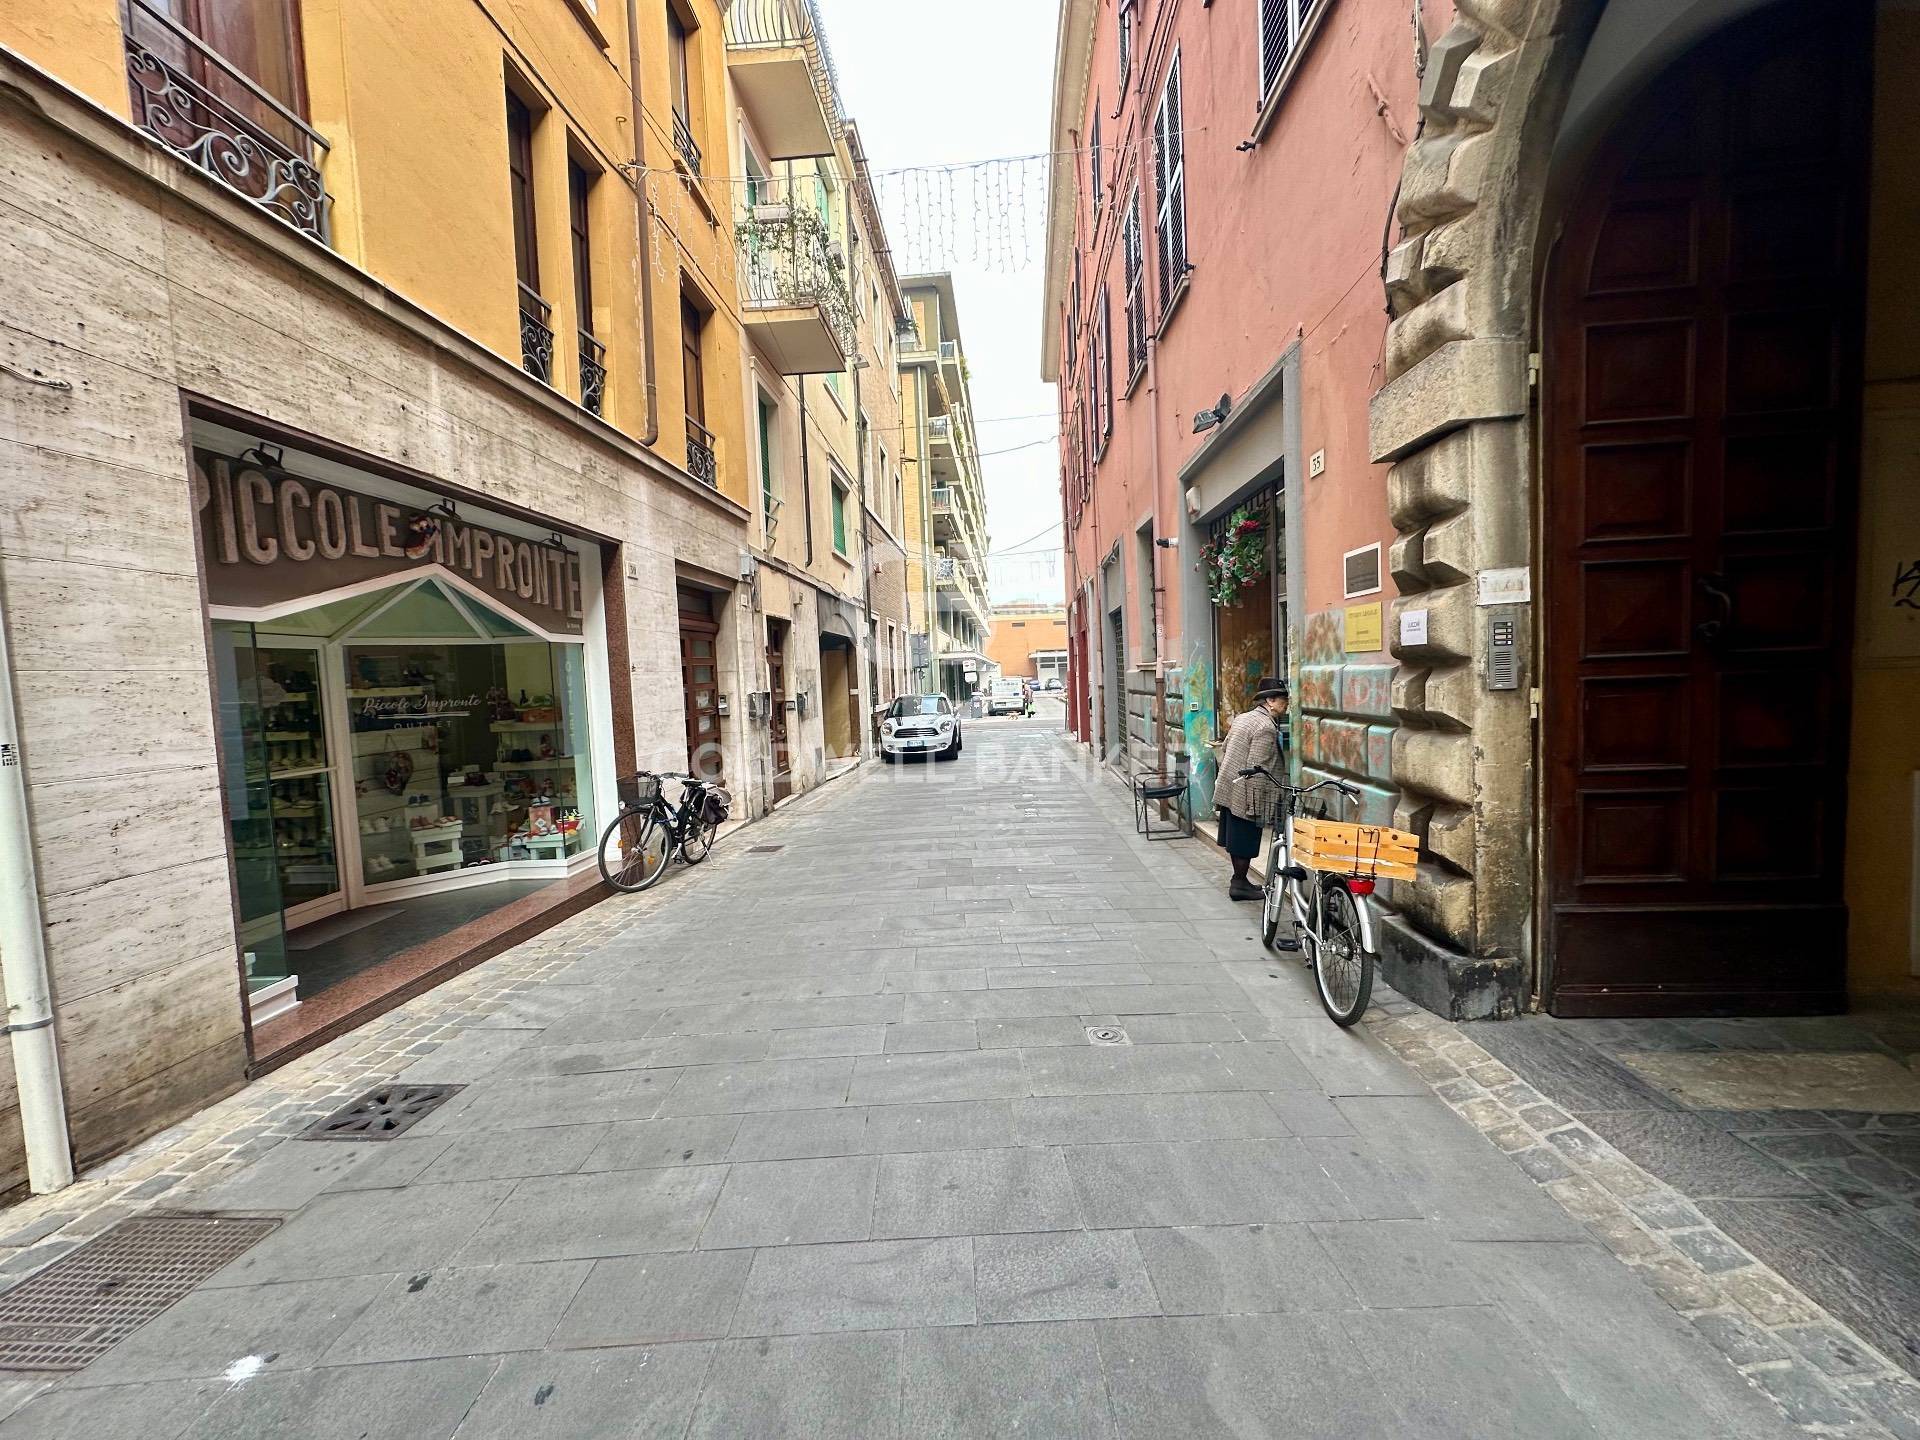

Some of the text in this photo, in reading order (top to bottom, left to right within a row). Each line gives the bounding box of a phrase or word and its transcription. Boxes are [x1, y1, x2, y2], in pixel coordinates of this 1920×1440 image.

[1312, 455, 1321, 472] 35
[430, 518, 584, 619] IMPRONTE
[394, 720, 454, 731] OUTLET
[0, 743, 11, 758] TIM
